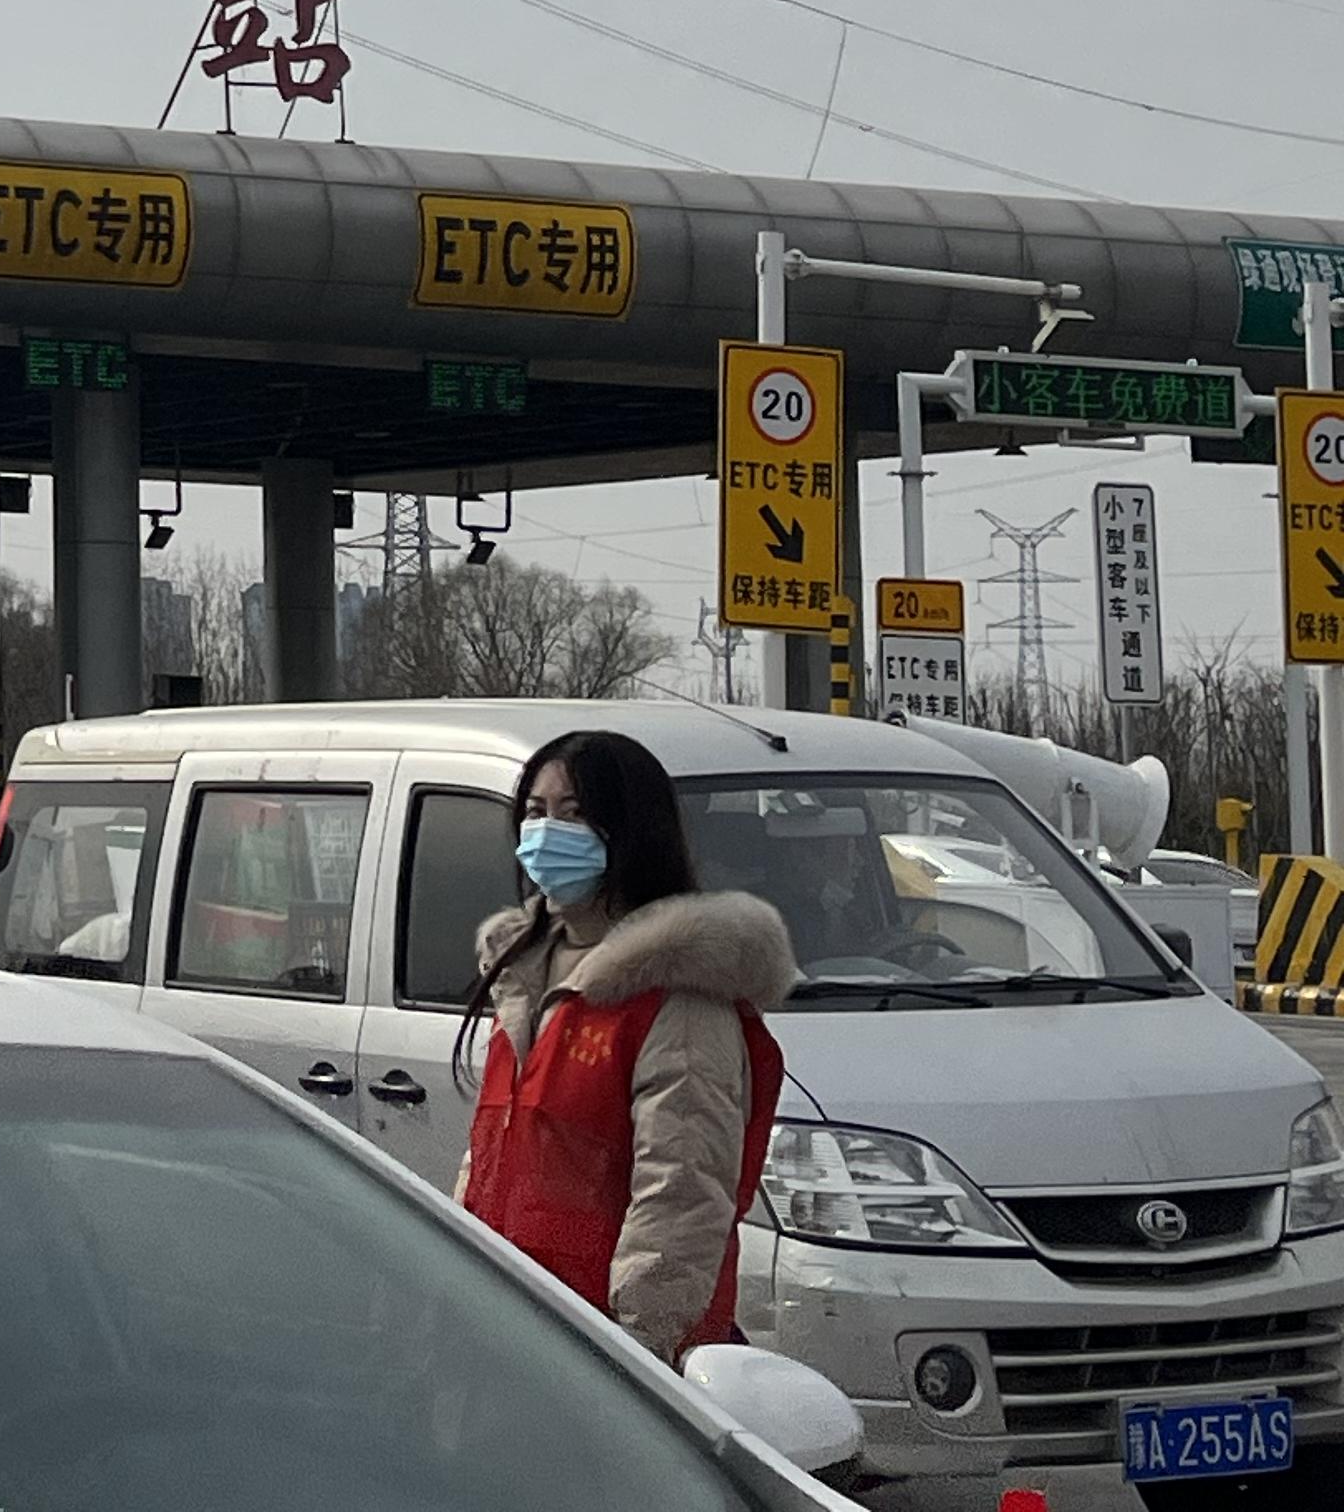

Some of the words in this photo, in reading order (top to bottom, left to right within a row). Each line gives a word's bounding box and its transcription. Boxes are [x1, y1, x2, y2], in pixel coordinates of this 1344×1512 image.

[432, 217, 620, 296] ETC专用
[25, 338, 129, 390] ETC
[762, 389, 803, 422] 20
[978, 361, 1232, 427] 小客车免费道
[729, 459, 832, 500] ETC专用
[1103, 494, 1129, 623] 小型客车
[731, 573, 831, 612] 保持车距
[893, 591, 919, 619] 20
[886, 656, 959, 681] ETC专用
[1122, 631, 1144, 692] 通道
